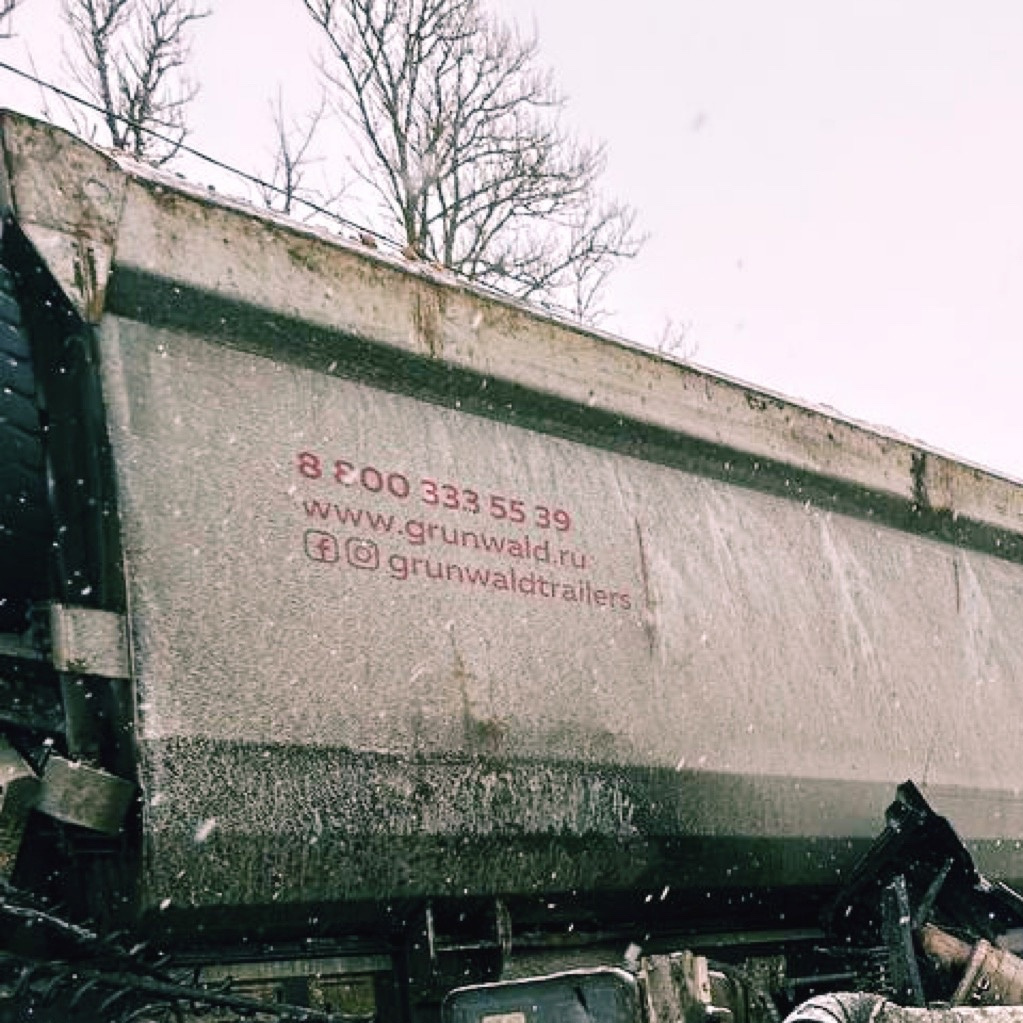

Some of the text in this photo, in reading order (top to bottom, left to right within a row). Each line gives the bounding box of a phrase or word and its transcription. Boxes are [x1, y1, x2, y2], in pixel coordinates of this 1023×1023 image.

[297, 451, 572, 533] 8 800 333 55 39
[303, 499, 588, 570] www.grunwald.ru
[389, 553, 632, 610] grunwaldtrailers
